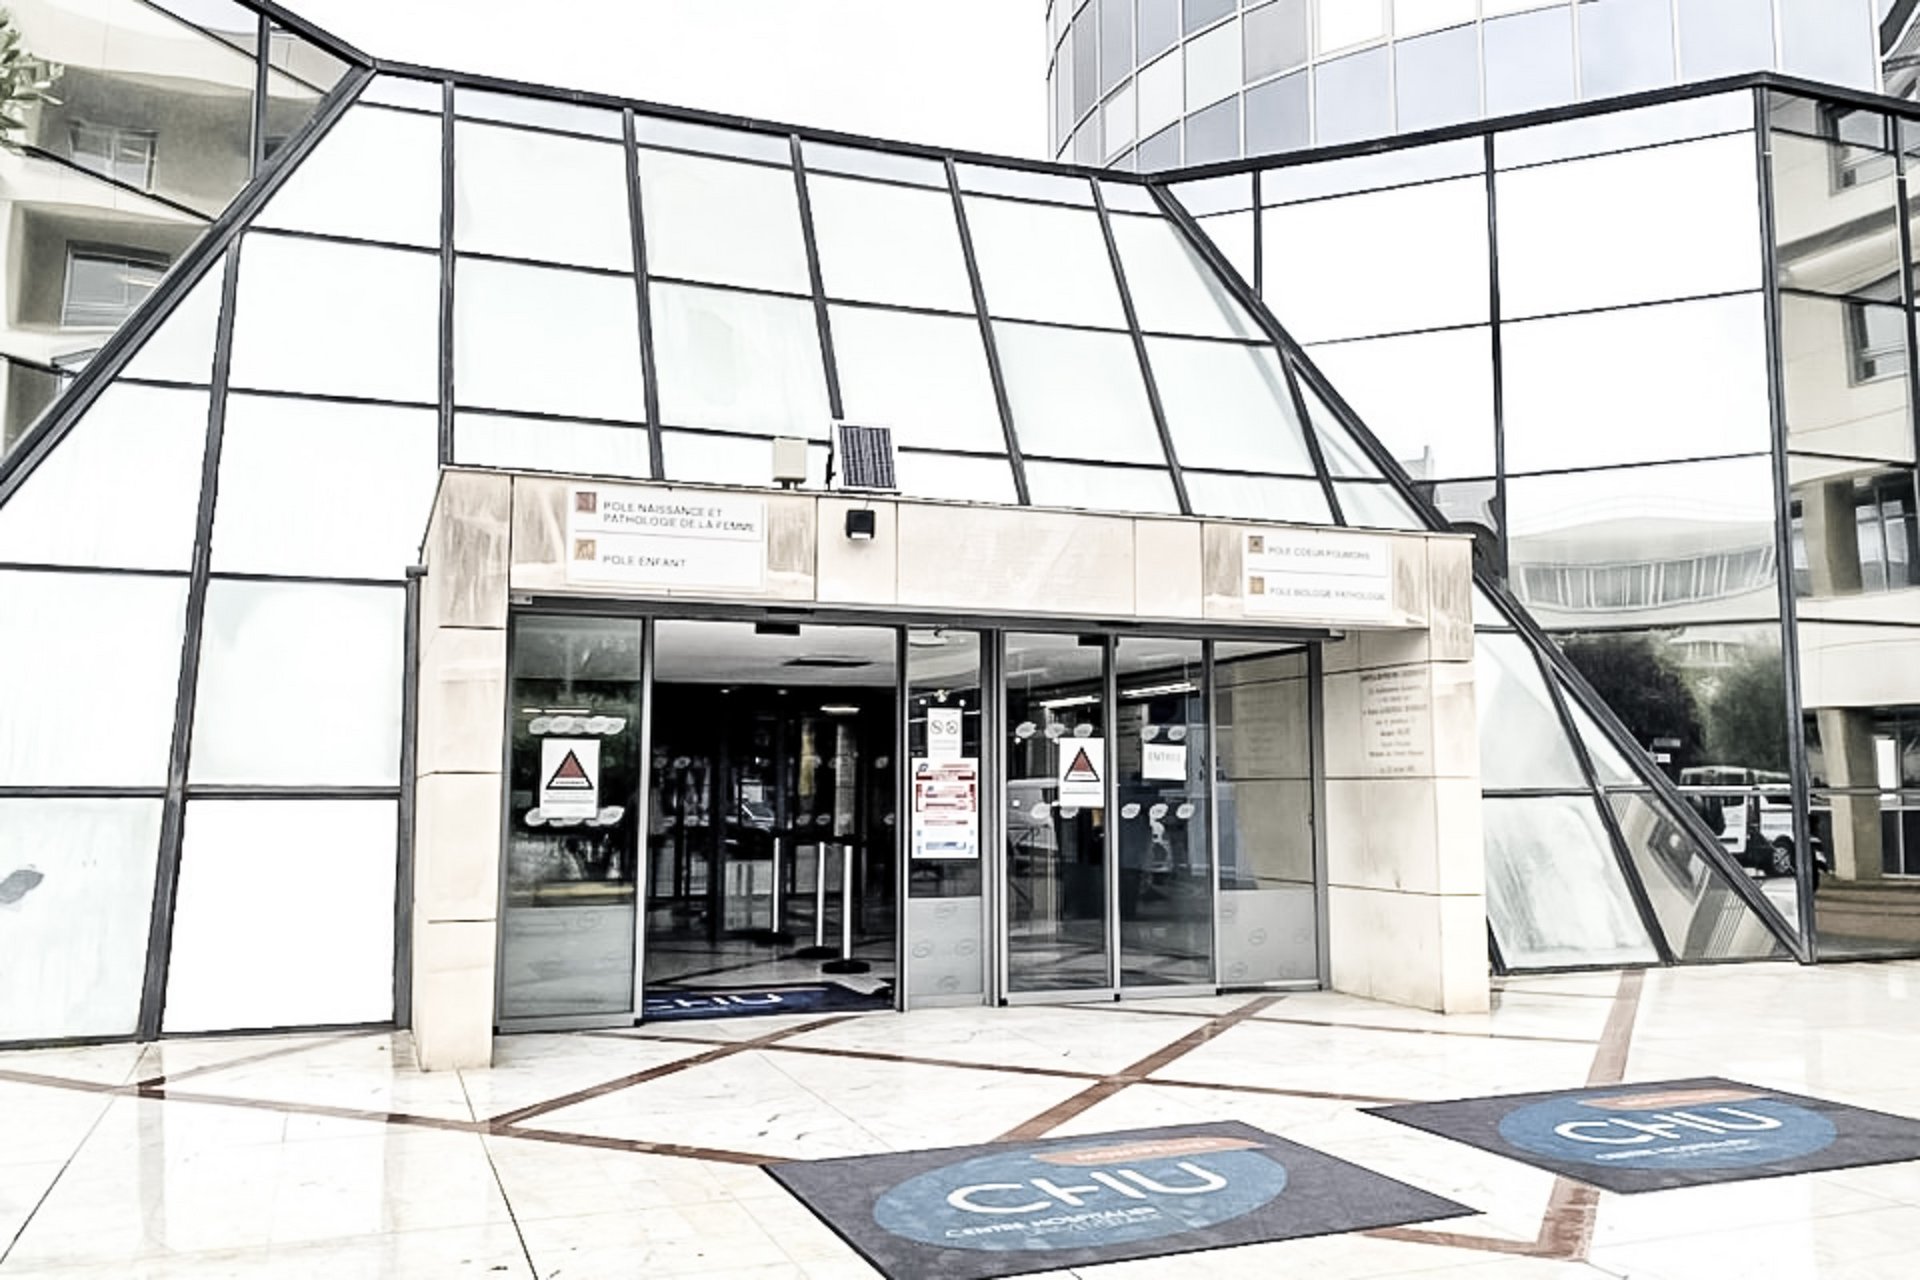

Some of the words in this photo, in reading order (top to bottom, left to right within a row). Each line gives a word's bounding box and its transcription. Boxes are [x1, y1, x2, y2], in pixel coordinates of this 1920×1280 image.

[603, 501, 633, 512] POLE
[637, 503, 704, 517] NAISSANCE
[707, 507, 722, 517] ET
[679, 518, 695, 529] DE
[698, 519, 713, 529] LA
[603, 555, 633, 566] POLE
[638, 556, 686, 568] ENFANT
[1554, 1107, 1782, 1144] CHU
[945, 1161, 1228, 1214] CHU
[945, 1222, 1026, 1239] CENTRE
